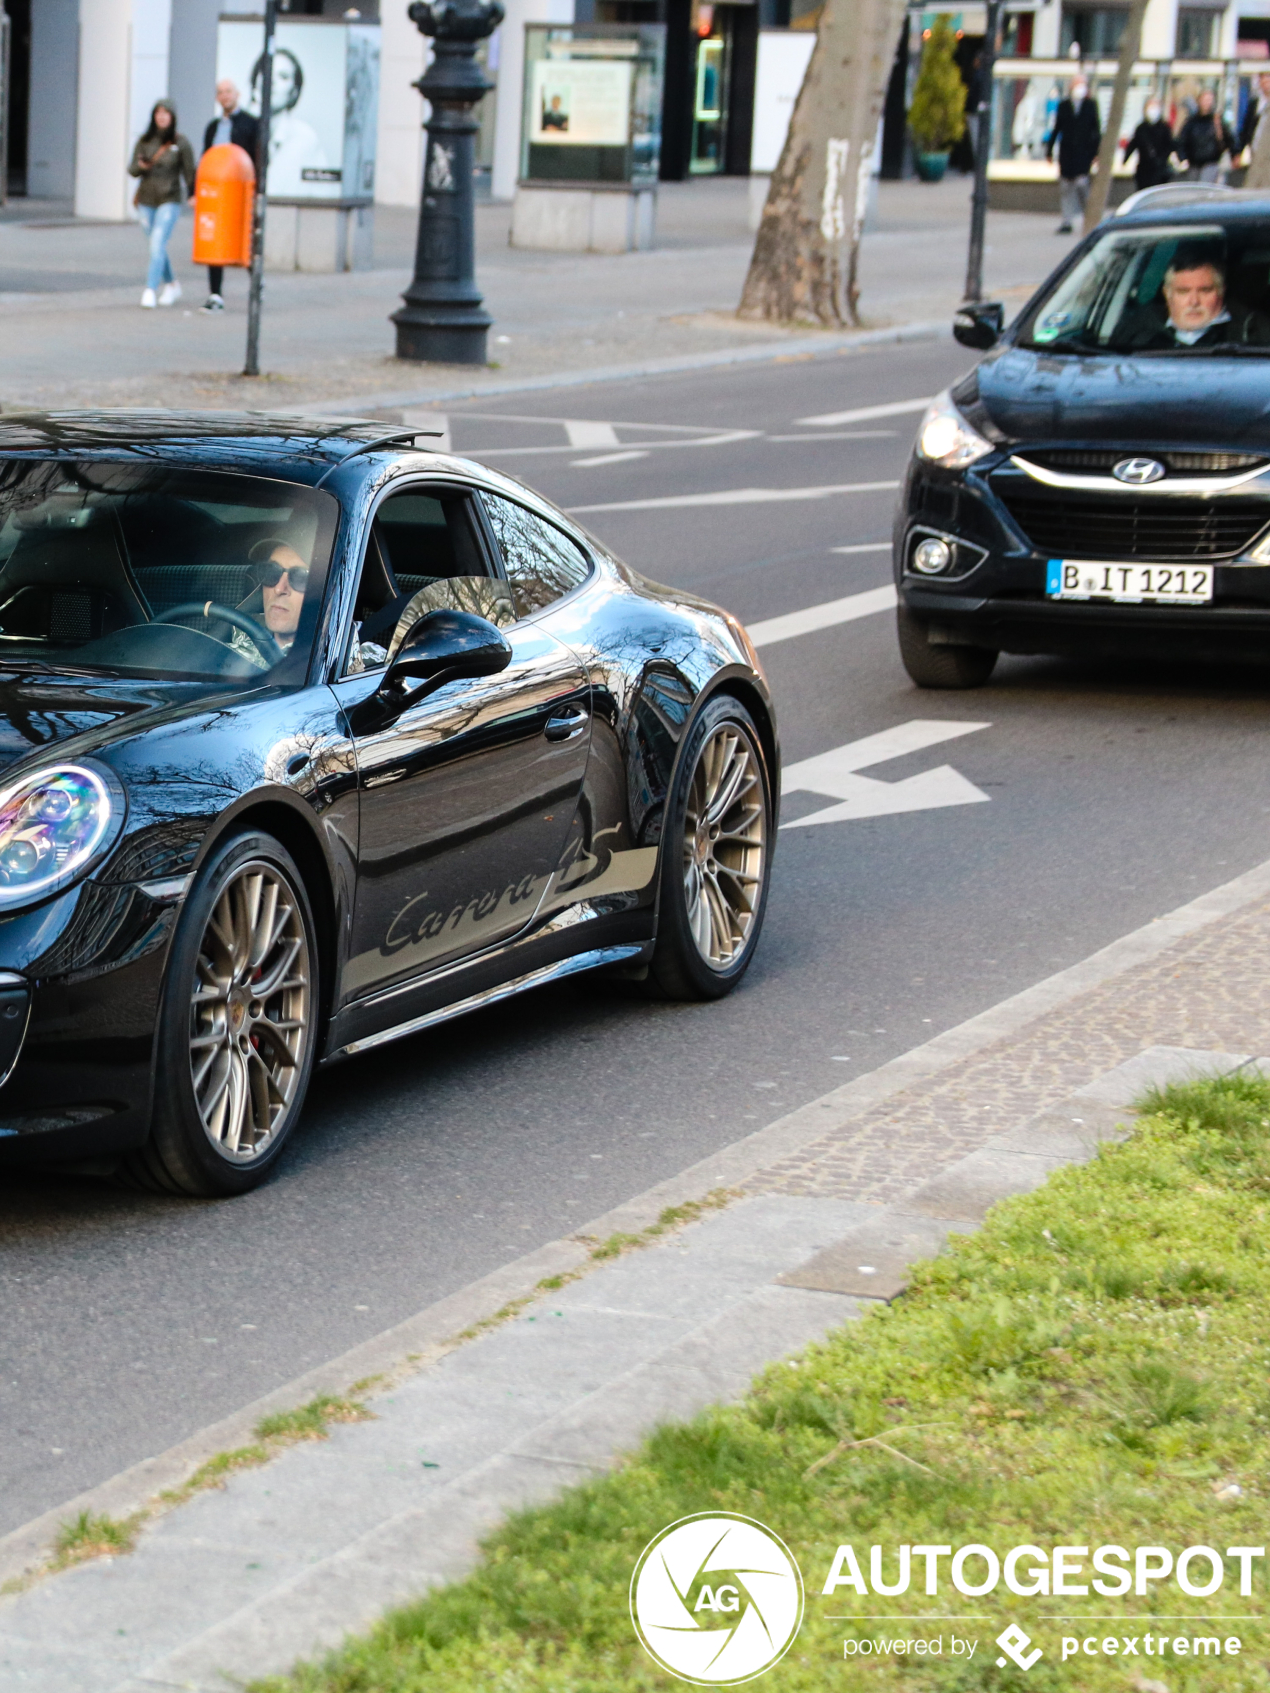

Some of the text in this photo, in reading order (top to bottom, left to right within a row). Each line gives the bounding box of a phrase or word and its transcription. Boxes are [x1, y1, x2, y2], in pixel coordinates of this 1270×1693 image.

[1063, 565, 1208, 595] B IT 1212
[380, 873, 538, 957] Carrera
